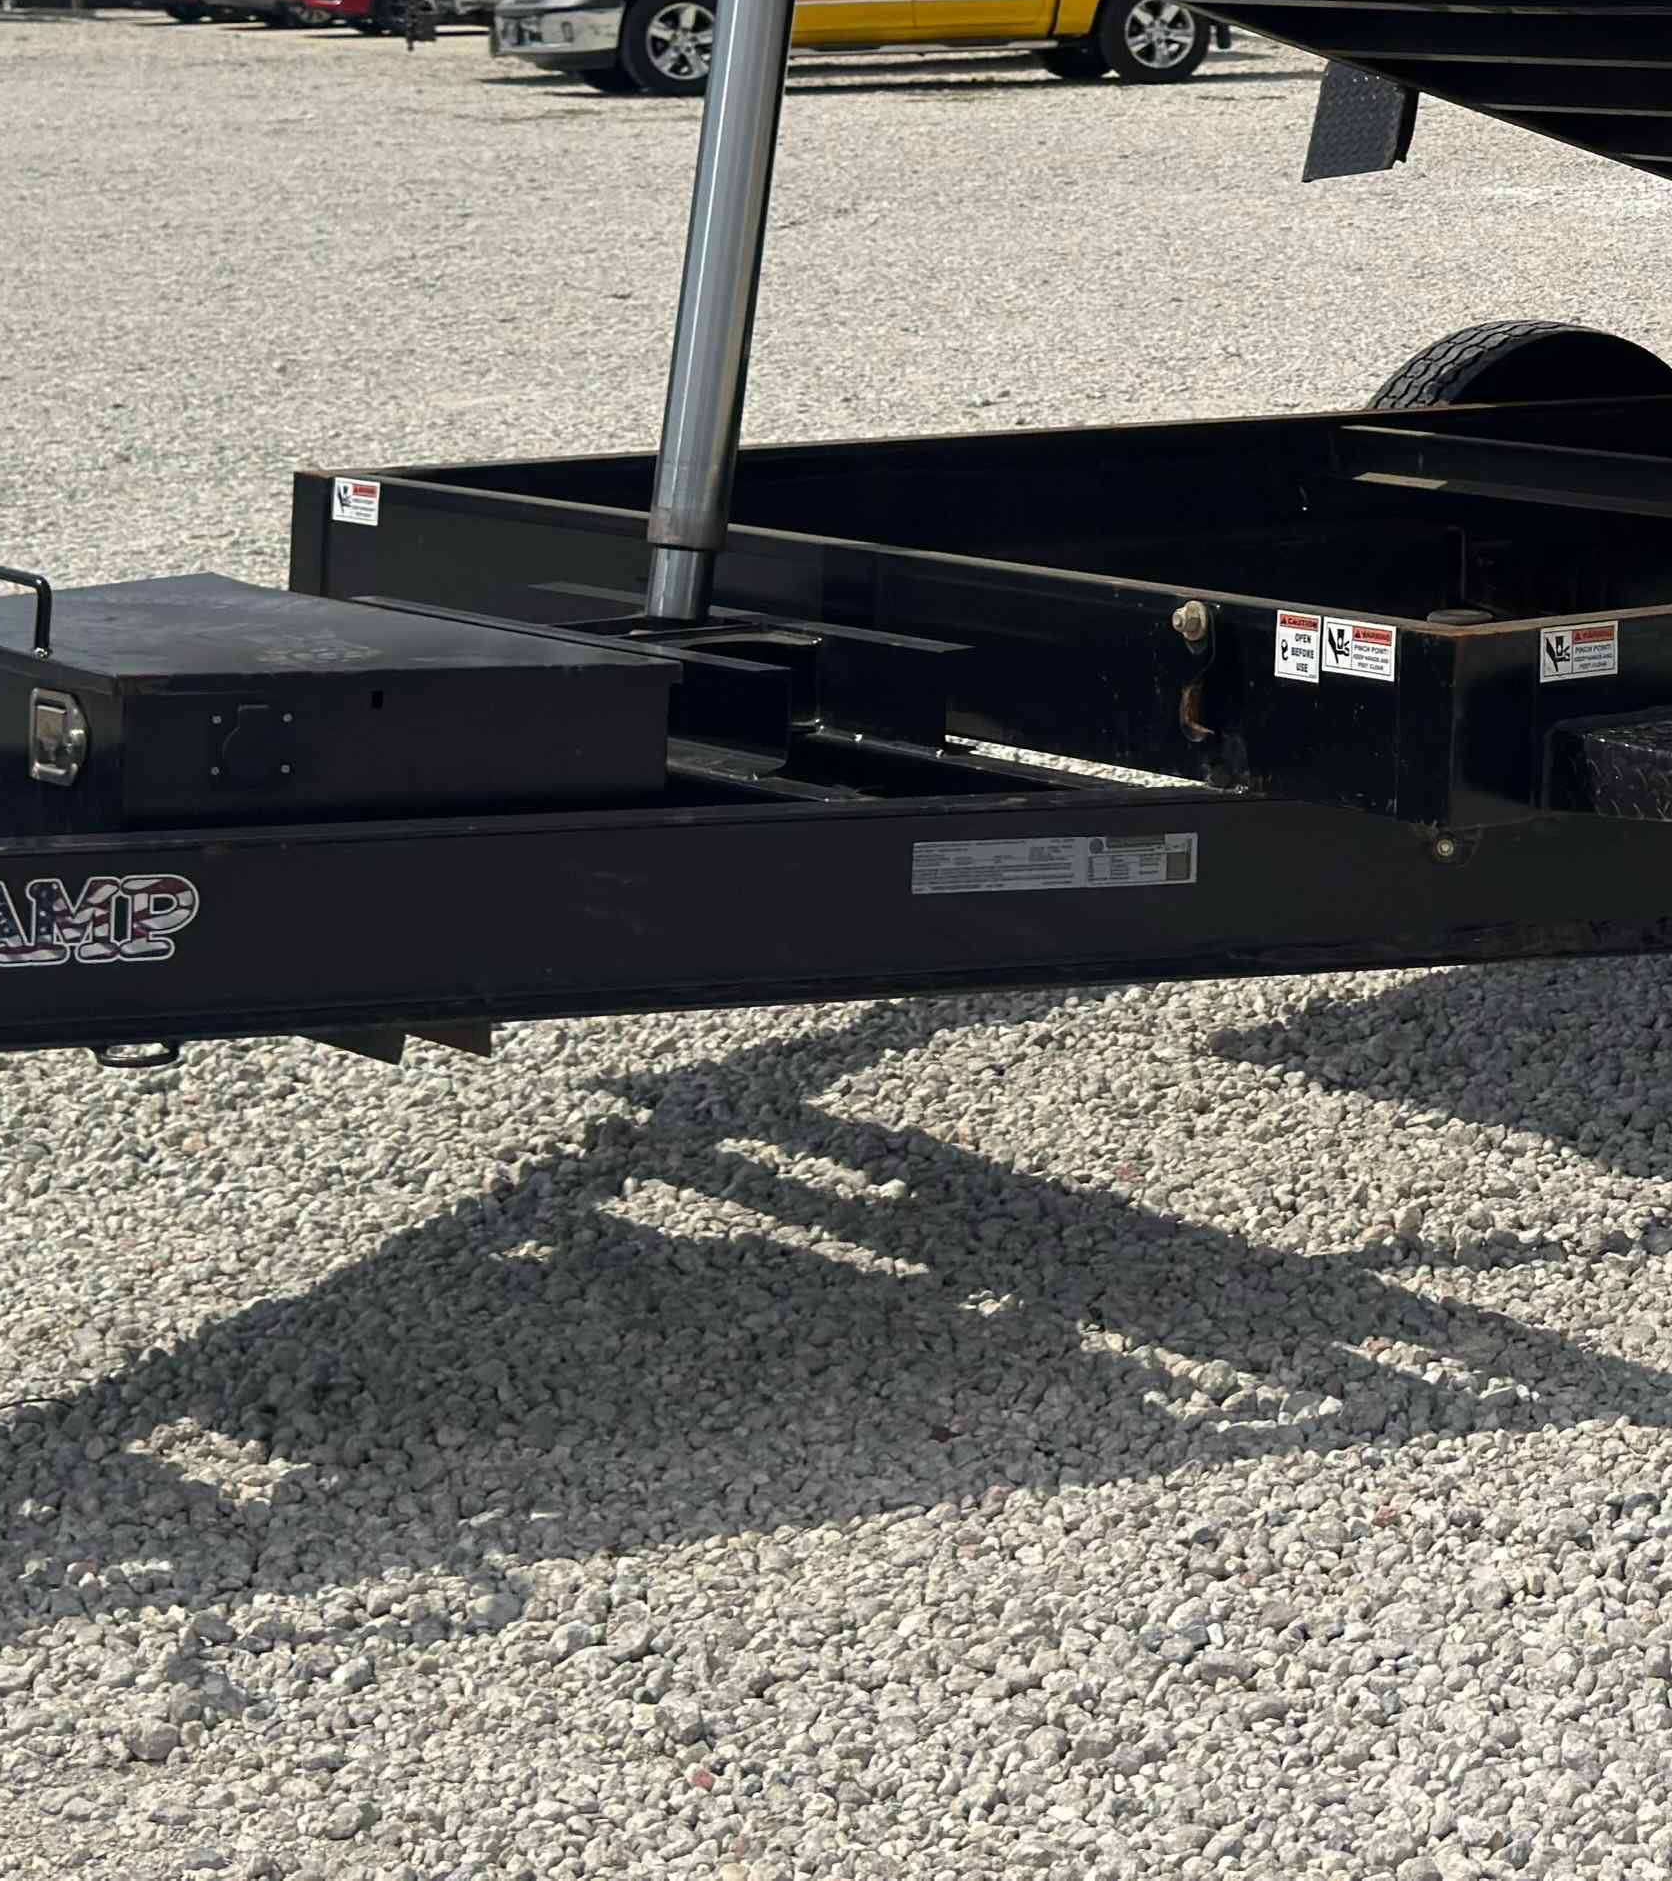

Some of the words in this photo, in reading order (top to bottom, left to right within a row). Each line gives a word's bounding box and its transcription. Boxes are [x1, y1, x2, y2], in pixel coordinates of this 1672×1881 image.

[1294, 632, 1312, 644] OPEN
[1290, 646, 1315, 660] BEFORE
[1295, 662, 1309, 673] USE
